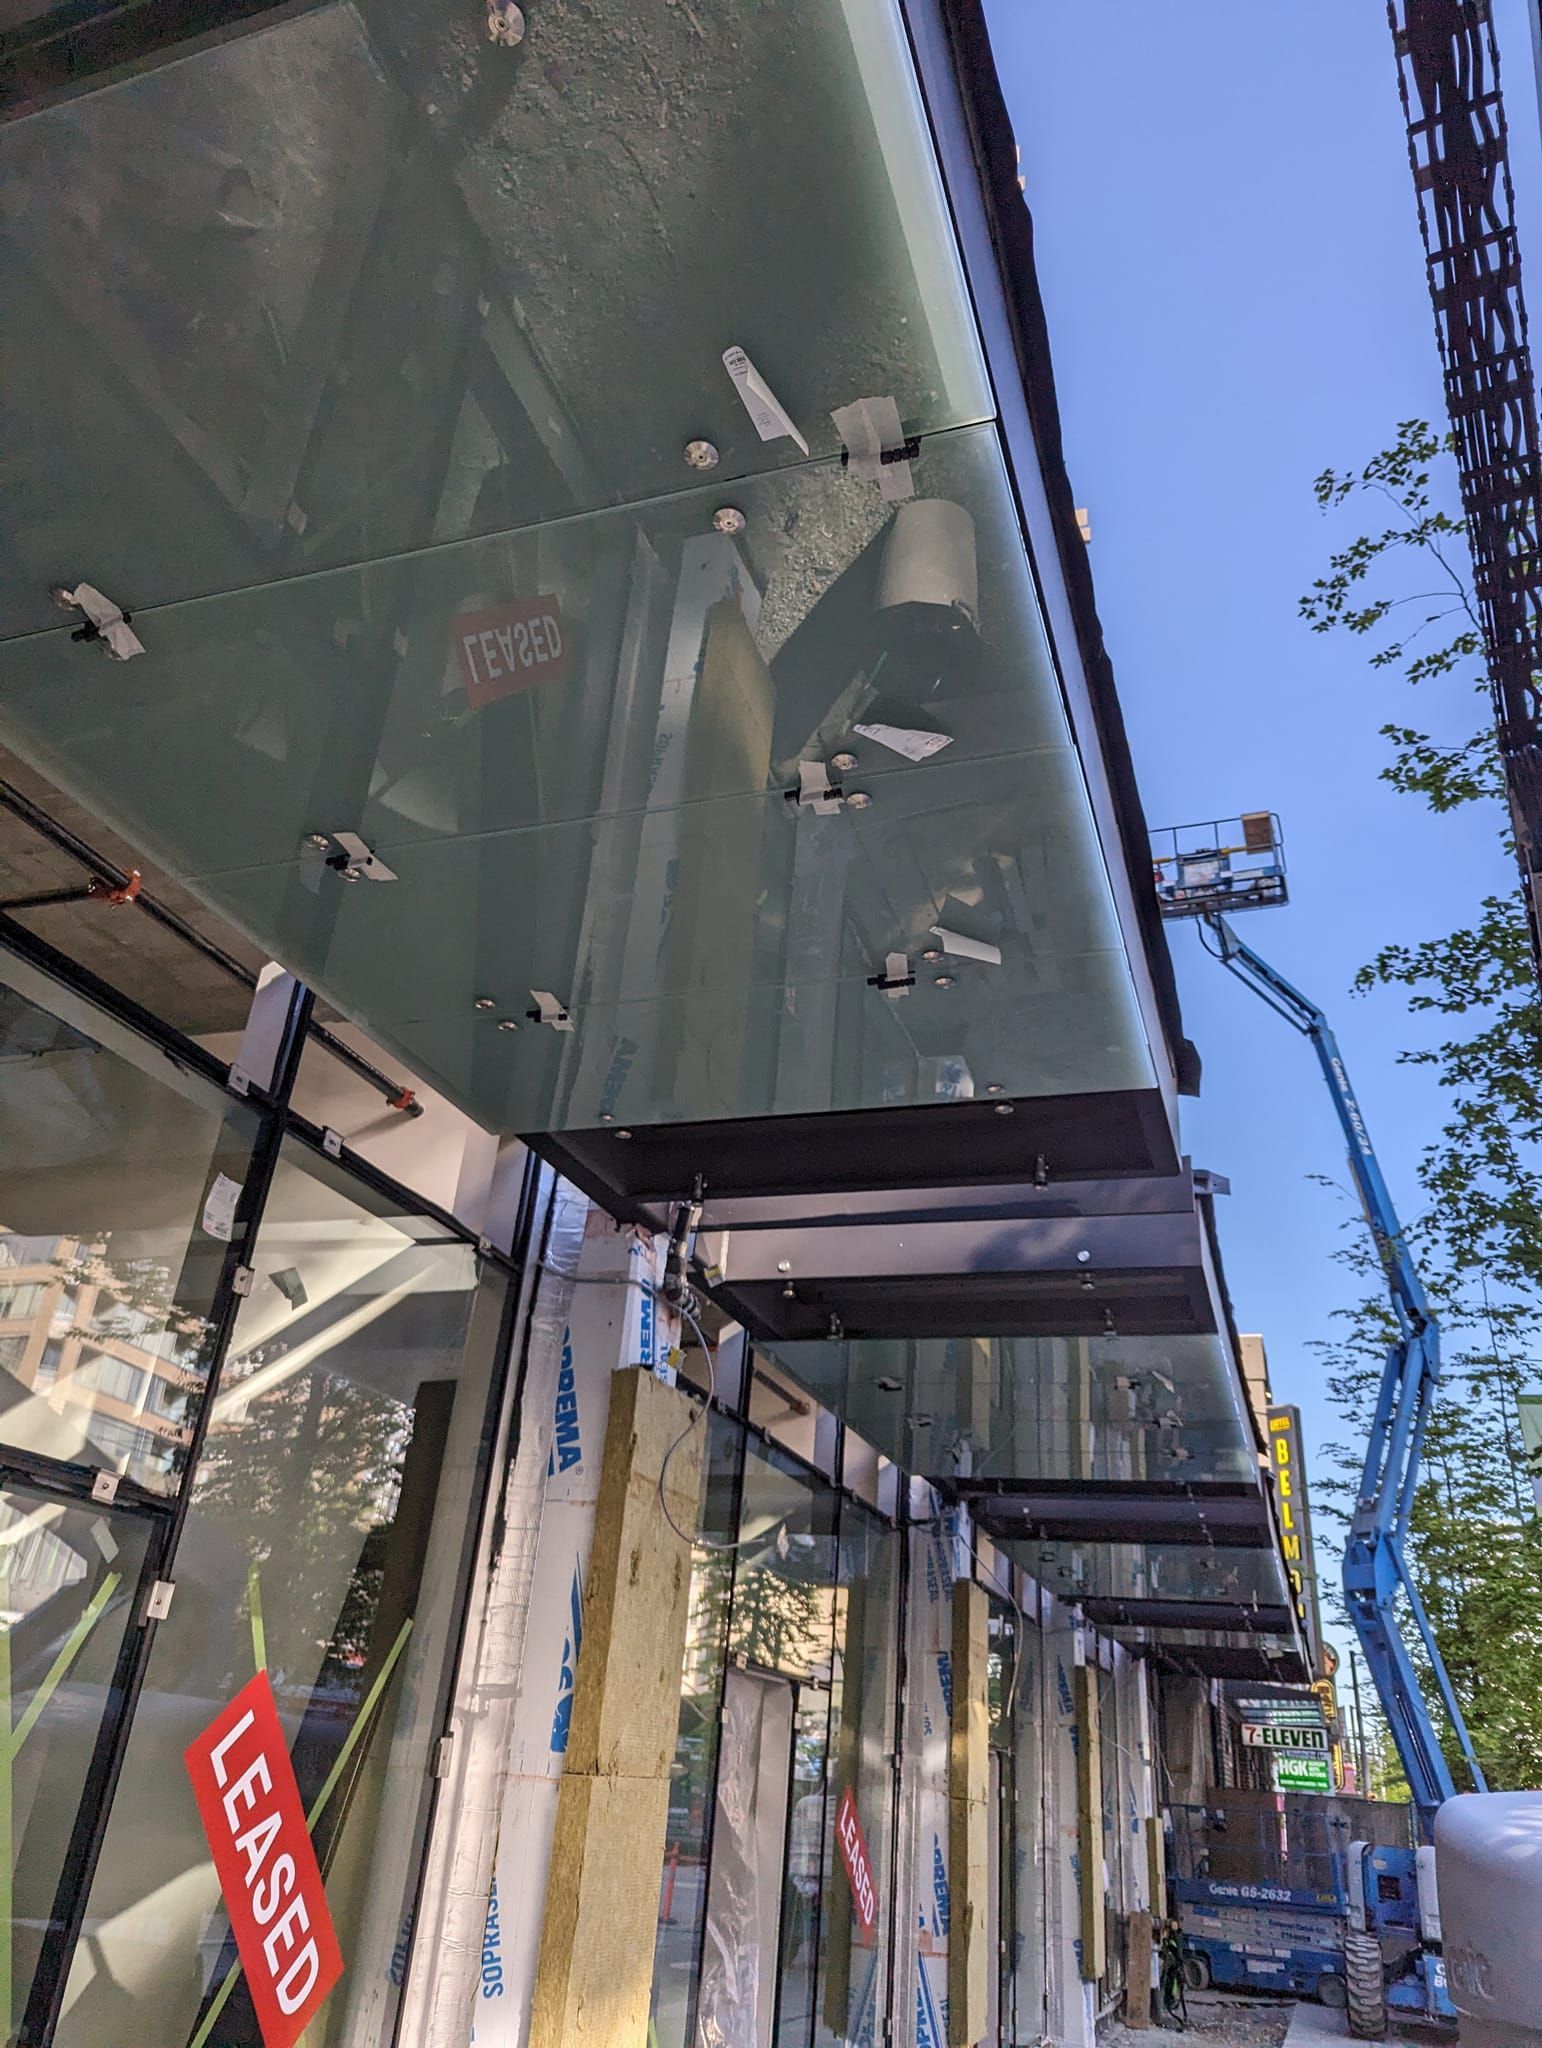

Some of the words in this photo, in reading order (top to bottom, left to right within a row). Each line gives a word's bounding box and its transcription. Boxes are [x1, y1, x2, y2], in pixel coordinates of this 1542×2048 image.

[555, 1326, 583, 1473] PREMA
[1279, 1758, 1309, 1777] HGK
[209, 1708, 320, 2016] LEASED
[840, 1799, 874, 1925] LEASED
[1209, 1883, 1239, 1896] Genie
[1241, 1885, 1292, 1902] GS-2632
